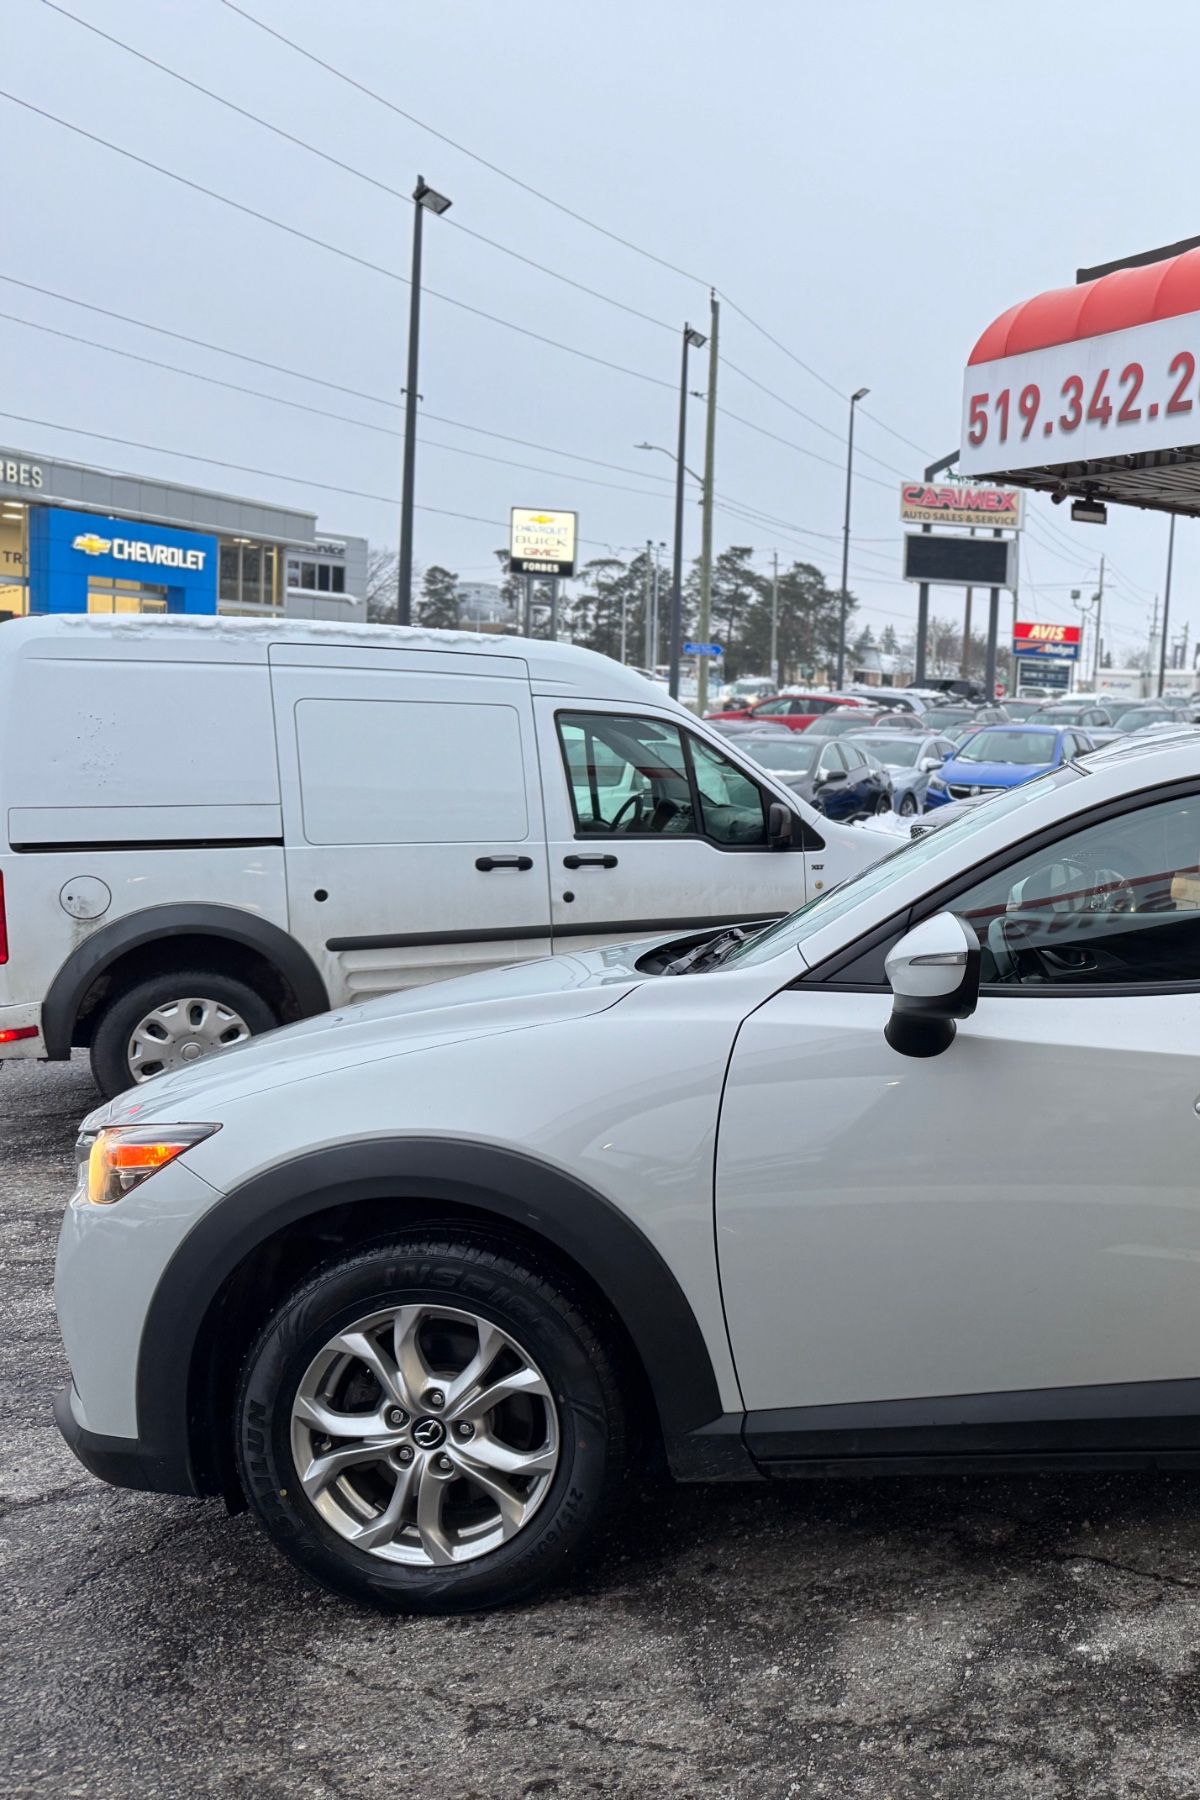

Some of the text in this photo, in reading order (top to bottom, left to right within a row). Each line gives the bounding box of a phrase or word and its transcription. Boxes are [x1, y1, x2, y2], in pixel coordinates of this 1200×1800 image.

[0, 461, 43, 488] BES
[902, 486, 1018, 511] CARIMEX
[903, 510, 1017, 526] AUTO SALES & SERVICE
[515, 535, 568, 547] BUICK
[112, 538, 206, 571] CHEVROLET
[523, 547, 560, 558] GMC
[522, 561, 560, 574] FORBES
[1028, 624, 1066, 641] AVIS
[1045, 643, 1075, 657] Budget
